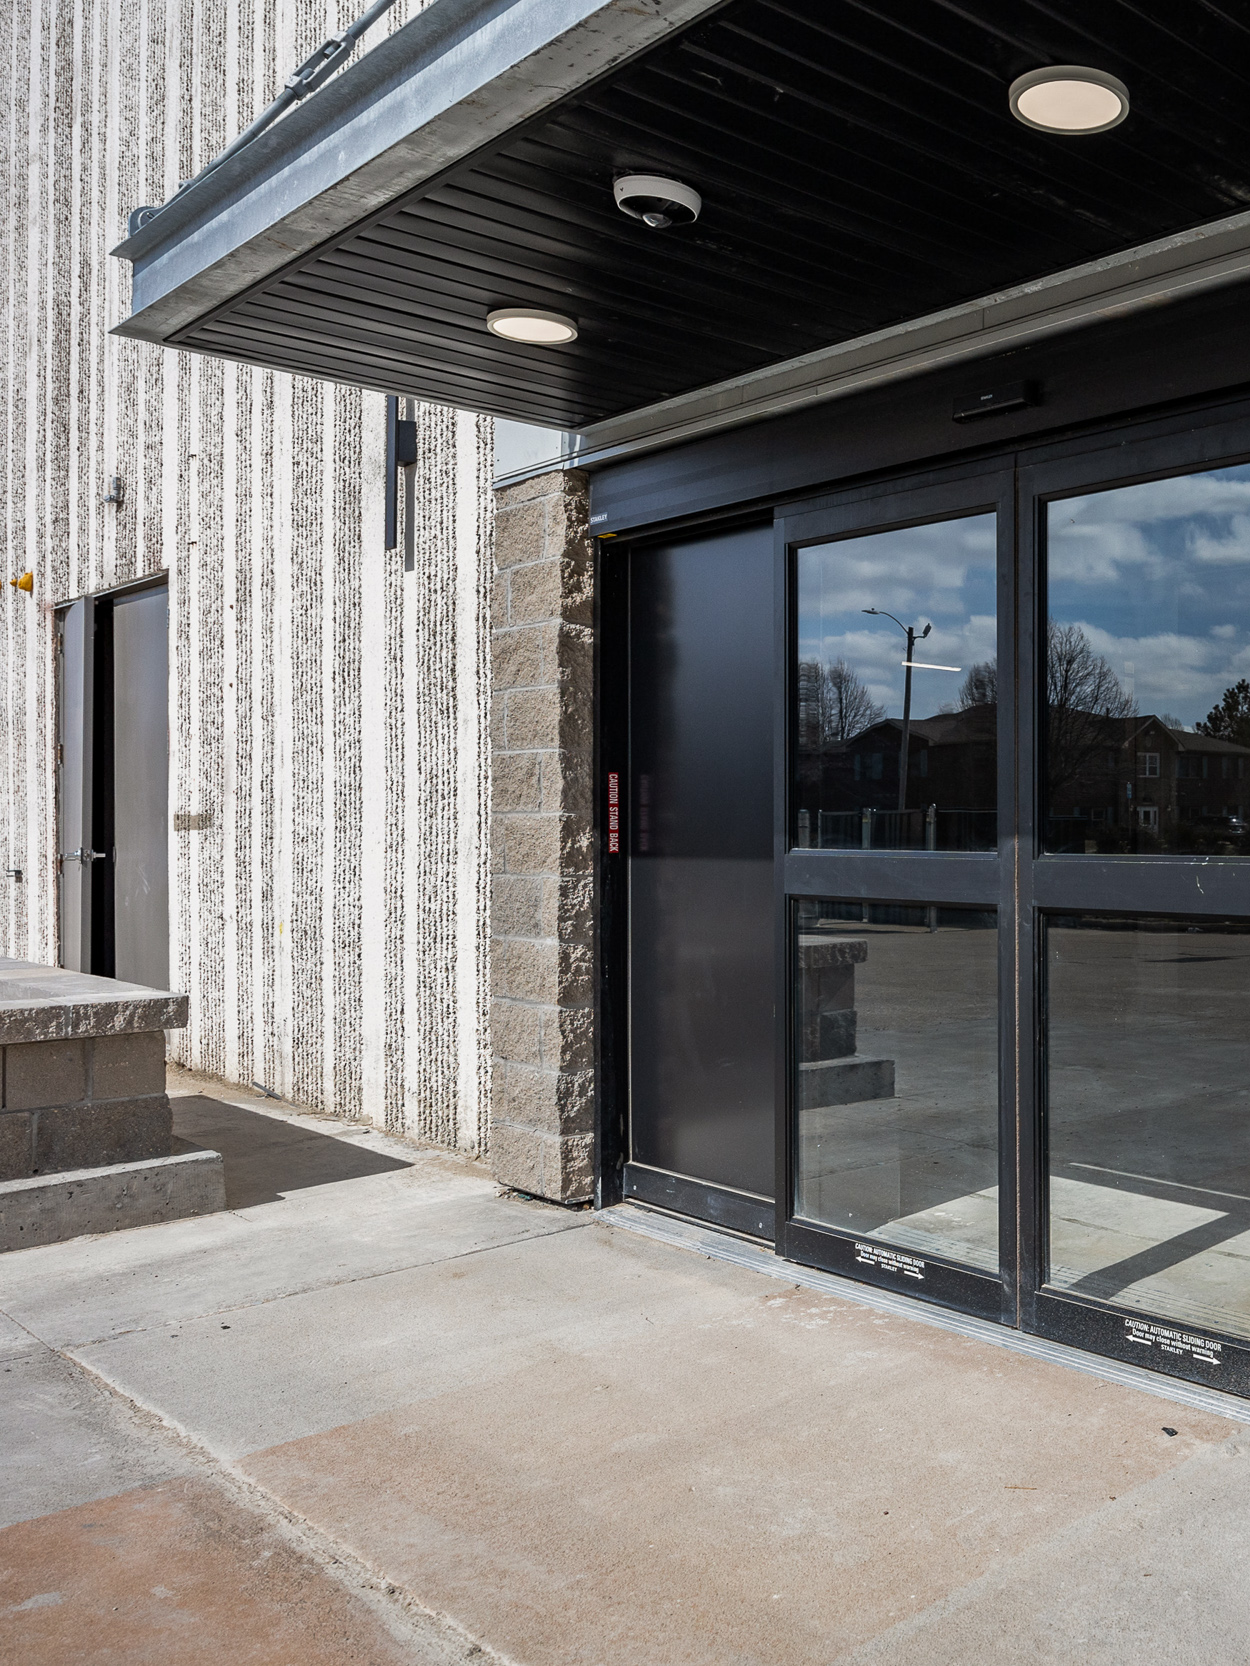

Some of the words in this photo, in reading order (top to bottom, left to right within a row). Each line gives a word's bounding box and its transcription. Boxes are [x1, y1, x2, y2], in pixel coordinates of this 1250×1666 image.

[609, 774, 618, 804] CAUTION
[609, 807, 618, 830] STAND
[609, 833, 618, 851] BACK
[873, 1248, 896, 1259] AUTOMATIC
[897, 1254, 912, 1265] SLIDING
[913, 1259, 925, 1268] DOOR
[1125, 1319, 1149, 1332] CAUTION:
[1150, 1326, 1182, 1341] AUTOMATIC
[1182, 1334, 1205, 1347] SLIDING
[1205, 1340, 1222, 1352] DOOR
[1132, 1328, 1144, 1338] Door
[1145, 1331, 1155, 1342] may
[1156, 1336, 1170, 1345] close
[1171, 1339, 1191, 1351] without
[1192, 1346, 1214, 1358] warning
